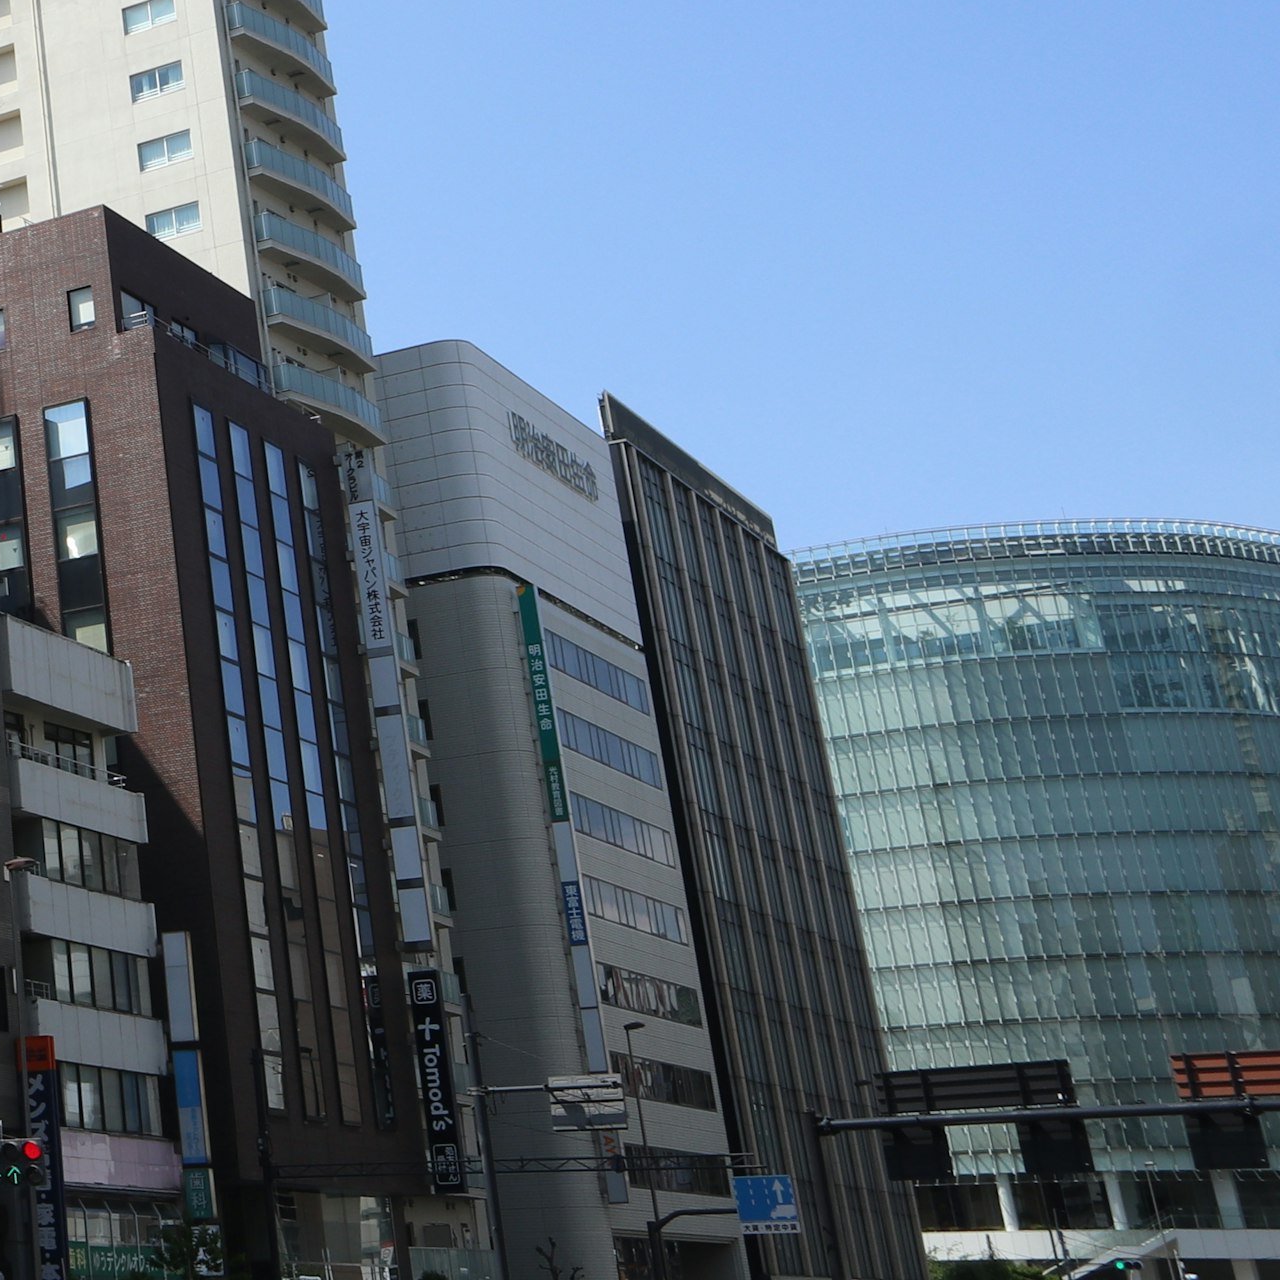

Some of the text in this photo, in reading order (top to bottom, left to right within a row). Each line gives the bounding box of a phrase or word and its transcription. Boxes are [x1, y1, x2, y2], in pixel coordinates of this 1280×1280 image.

[355, 510, 385, 640] 大宇宙ジャパン株式会社
[528, 643, 553, 731] 明治安田生命
[563, 885, 586, 941] 東富士電機
[416, 983, 433, 1001] 薬
[422, 1044, 453, 1132] Tomod's
[189, 1172, 209, 1209] 歯科
